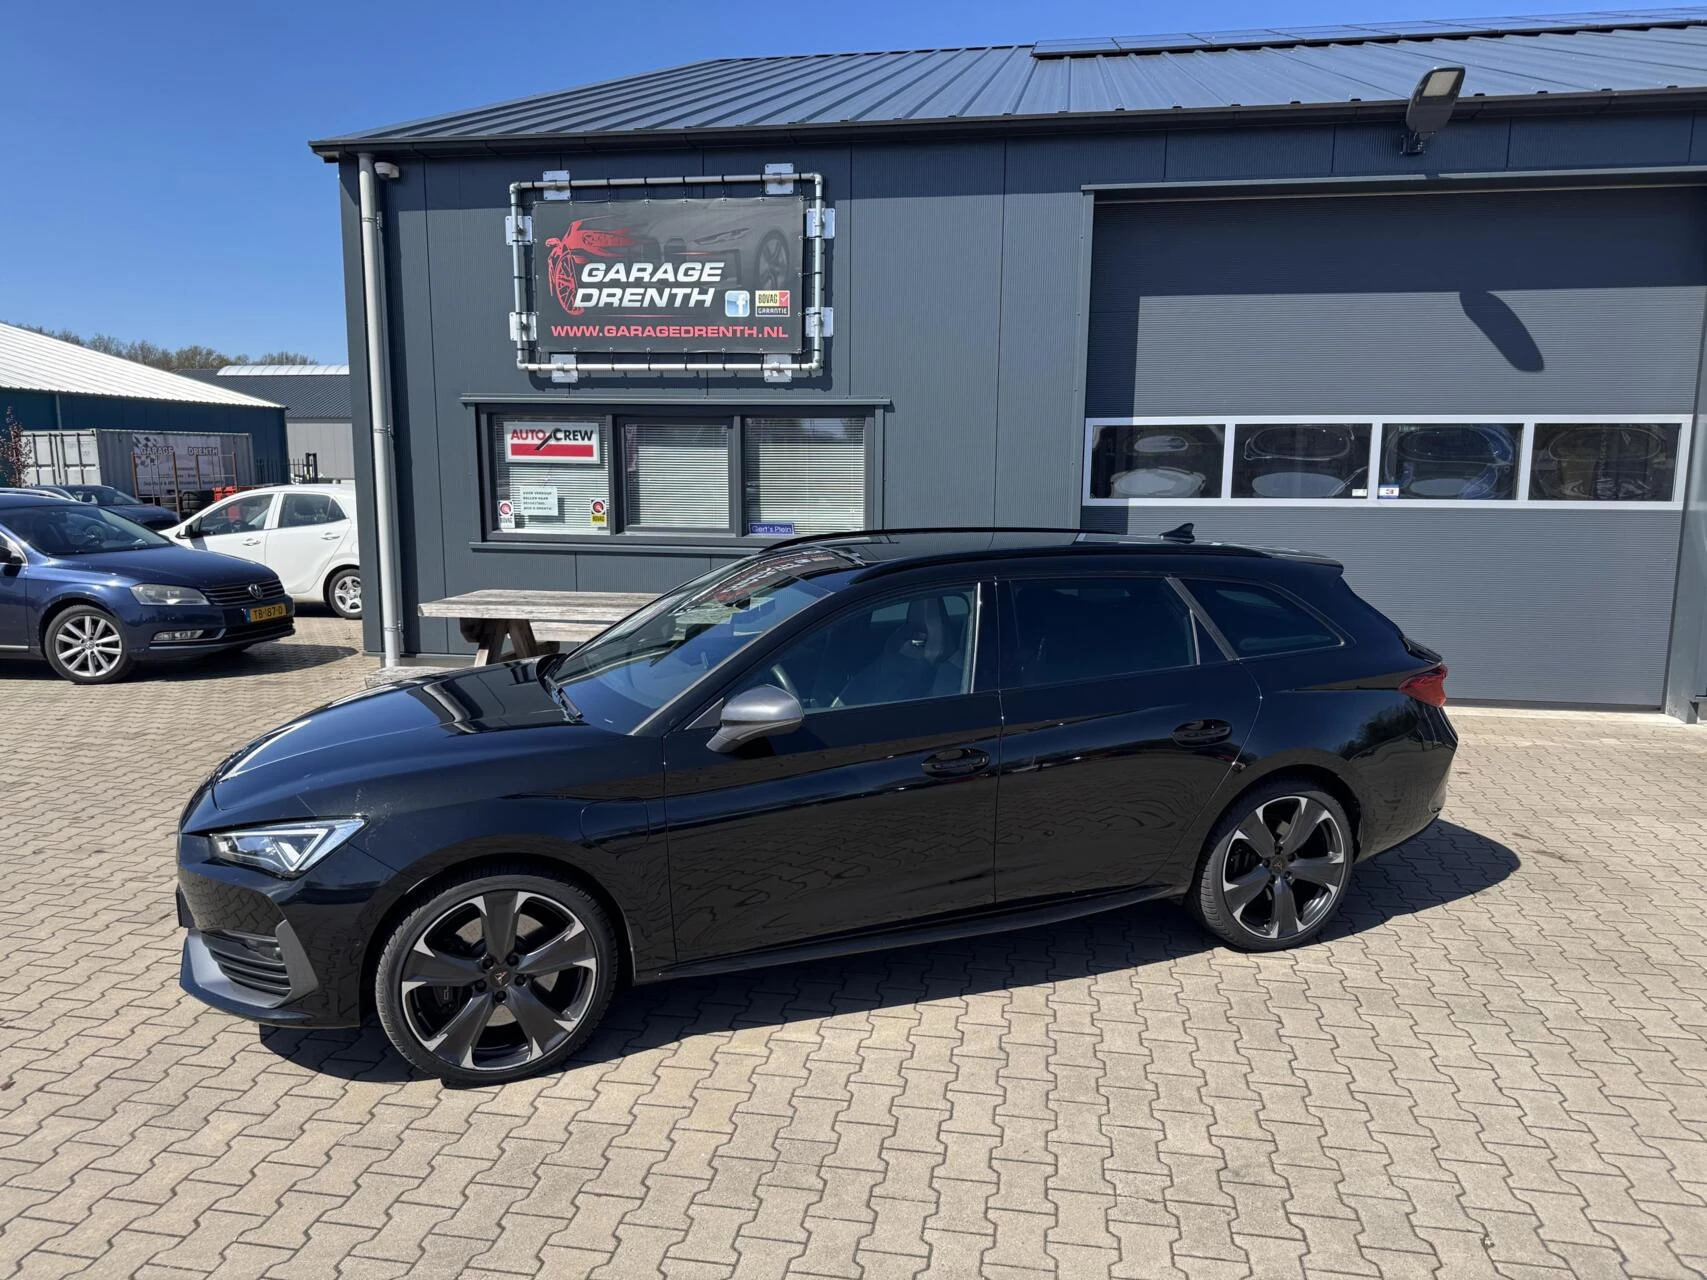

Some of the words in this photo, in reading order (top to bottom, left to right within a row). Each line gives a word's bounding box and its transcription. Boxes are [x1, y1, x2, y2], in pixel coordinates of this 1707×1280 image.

[580, 262, 725, 282] GARAGE
[573, 288, 716, 308] DRENTH
[758, 294, 778, 304] BOVAG
[551, 325, 789, 338] WWW.GARAGEDRENTH.NL
[511, 429, 546, 440] AUTO
[552, 428, 593, 441] CREW
